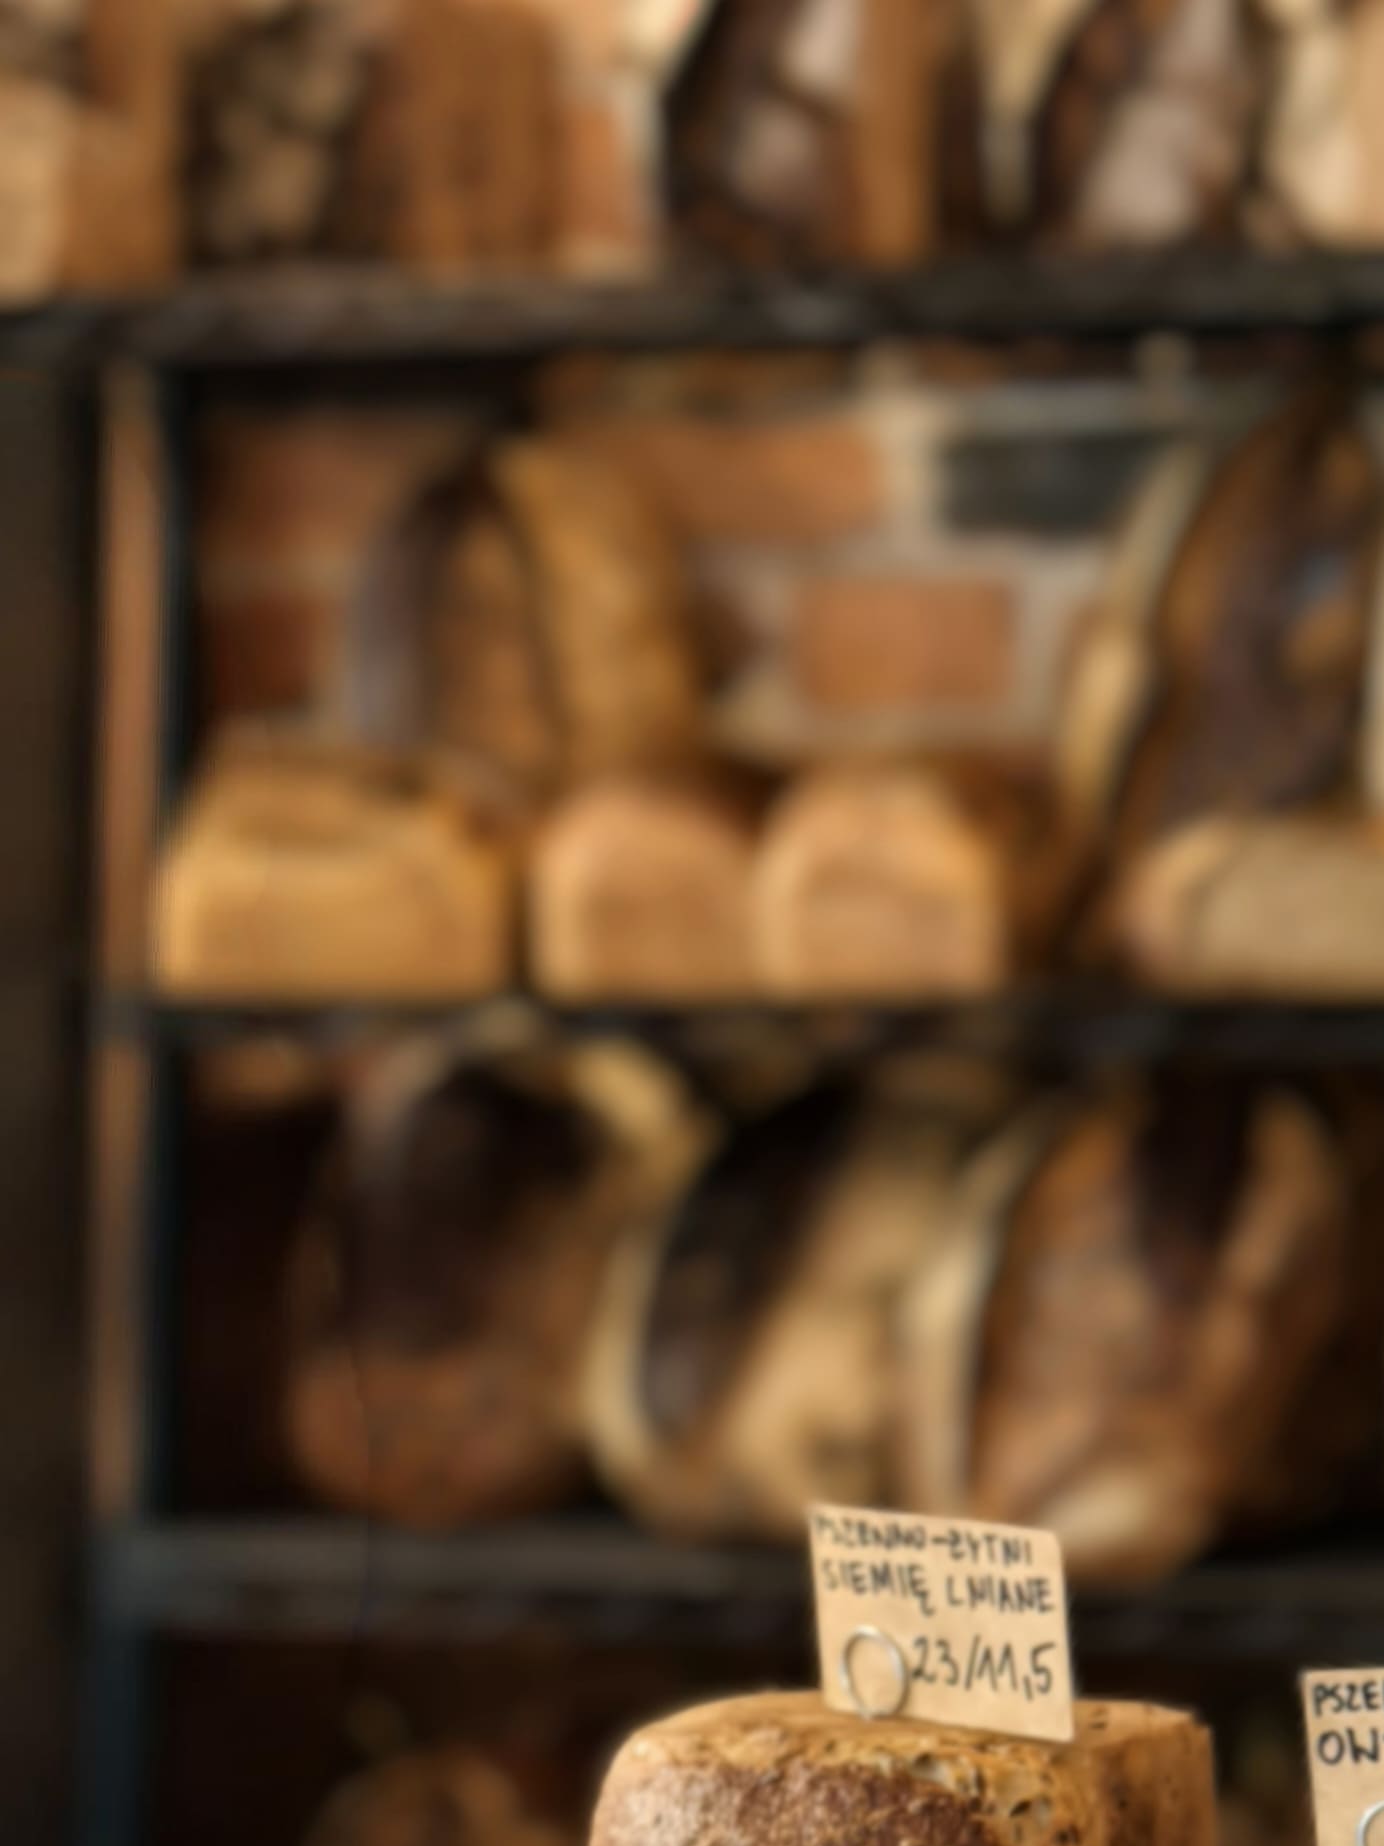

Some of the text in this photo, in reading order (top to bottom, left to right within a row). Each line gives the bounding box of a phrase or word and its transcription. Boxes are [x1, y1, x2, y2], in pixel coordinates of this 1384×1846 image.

[821, 1558, 1054, 1616] SIEMIĘ LNIANE
[910, 1634, 1055, 1700] 23/11,5
